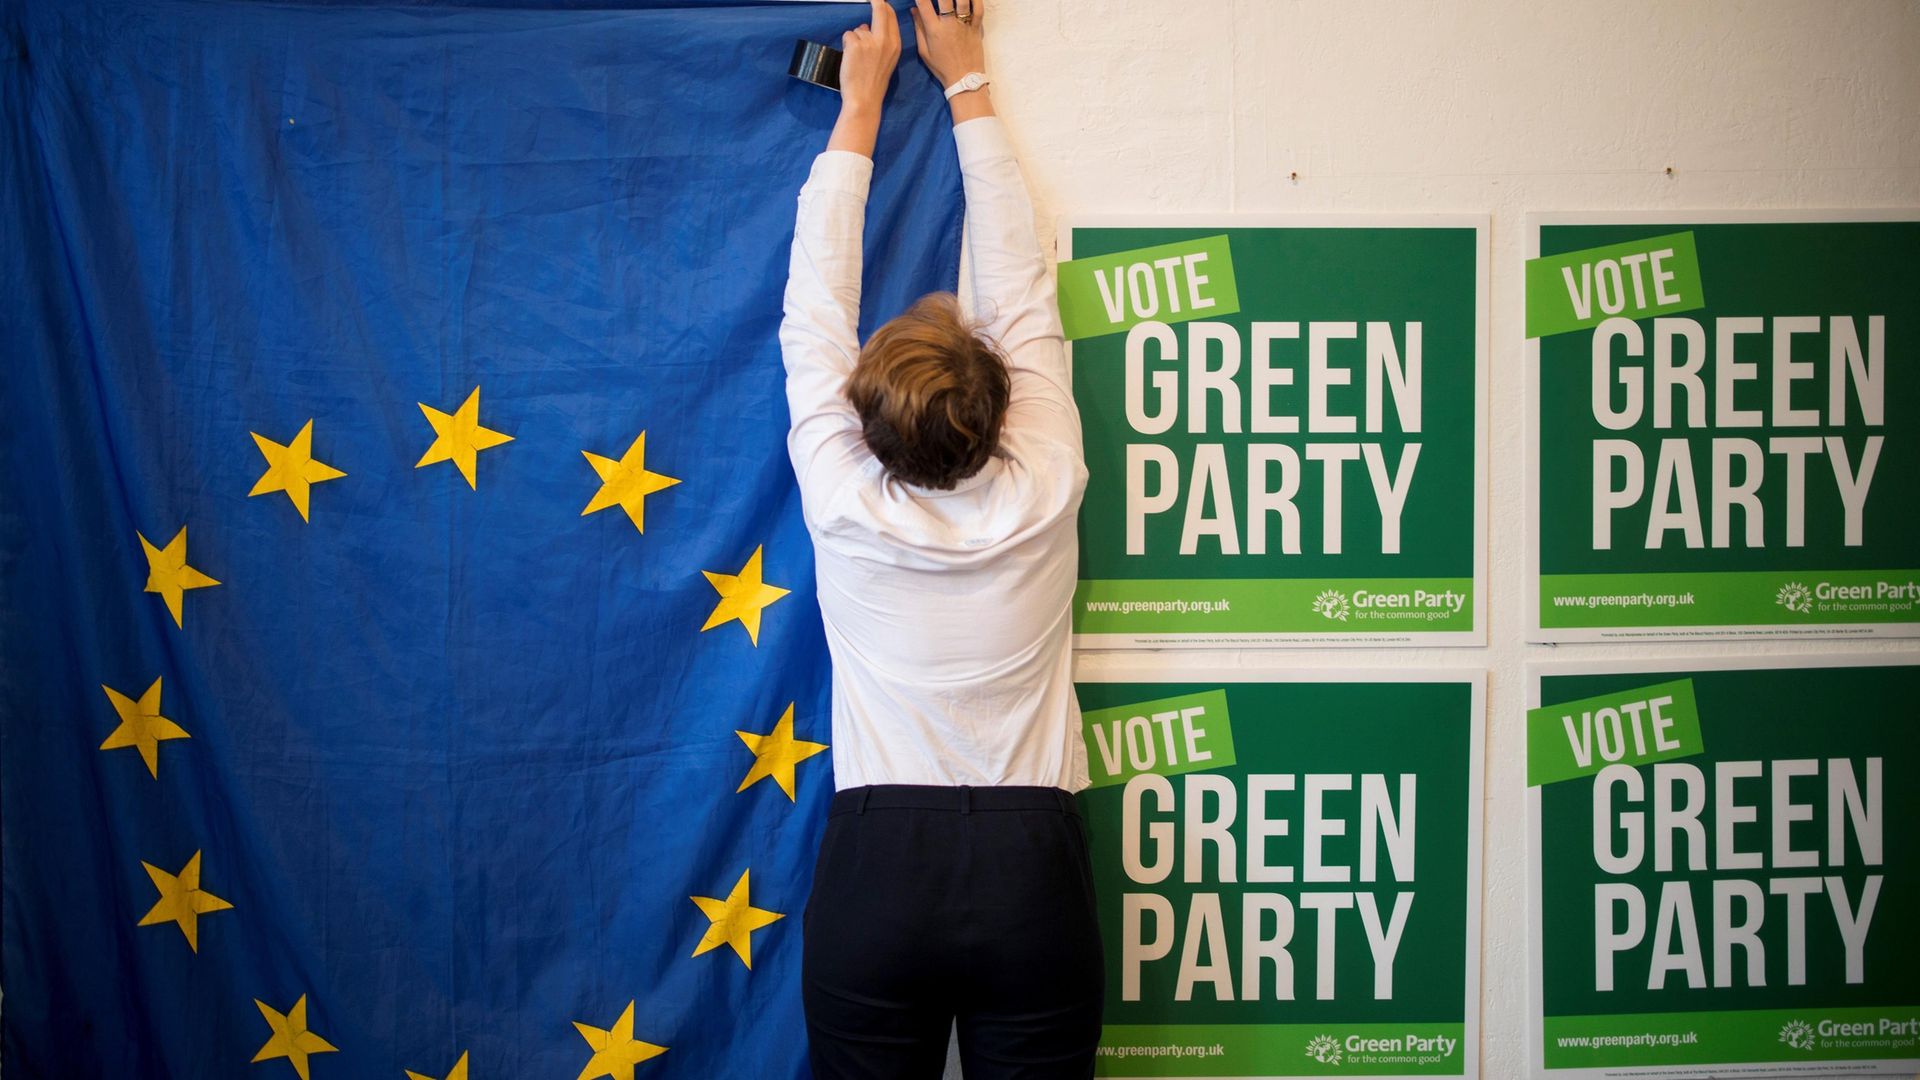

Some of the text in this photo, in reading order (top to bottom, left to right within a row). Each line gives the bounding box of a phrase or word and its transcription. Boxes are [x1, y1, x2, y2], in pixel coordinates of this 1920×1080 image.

[1094, 251, 1216, 323] VOTE
[1562, 248, 1680, 320] VOTE
[1124, 320, 1423, 436] GREEN
[1592, 315, 1885, 430] GREEN
[1126, 443, 1422, 556] PARTY
[1593, 436, 1885, 550] PARTY
[1087, 597, 1230, 615] www.greenparty.org.uk
[1352, 589, 1466, 613] Green Party
[1553, 592, 1695, 609] www.greenparty.org.uk
[1815, 582, 1873, 600] Green
[1818, 602, 1912, 613] for the common good
[1355, 610, 1450, 621] for the common good
[1092, 706, 1212, 776] VOTE
[1562, 695, 1680, 768] VOTE
[1122, 773, 1417, 884] GREEN
[1593, 757, 1883, 875] GREEN
[1122, 892, 1415, 1001] PARTY
[1595, 875, 1883, 991] PARTY
[1096, 1044, 1225, 1059] ww.greenparty.org.uk
[1345, 1034, 1457, 1057] Green Party
[1557, 1031, 1698, 1049] www.greenparty.org.uk
[1818, 1017, 1920, 1041] Green Part
[1821, 1038, 1915, 1049] for the common good
[1347, 1055, 1441, 1066] for the common good
